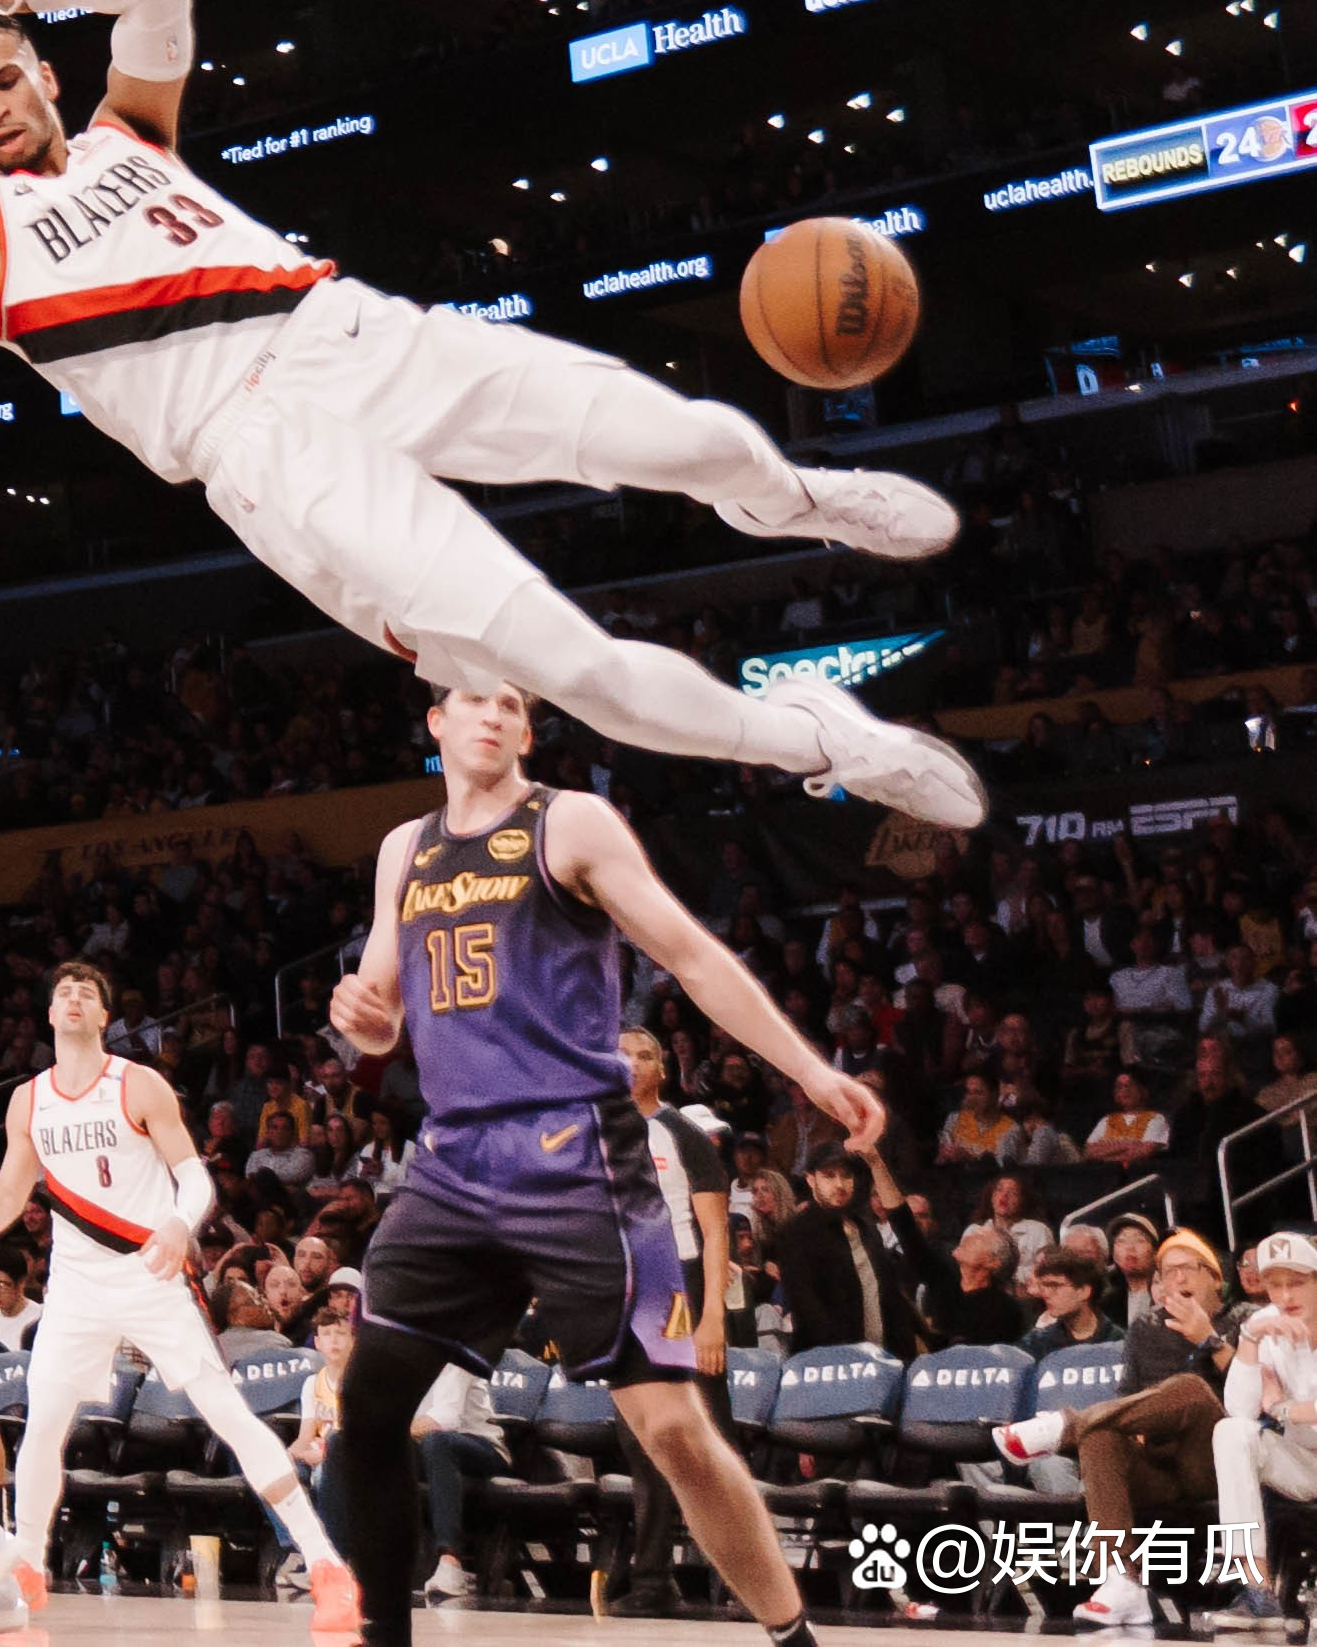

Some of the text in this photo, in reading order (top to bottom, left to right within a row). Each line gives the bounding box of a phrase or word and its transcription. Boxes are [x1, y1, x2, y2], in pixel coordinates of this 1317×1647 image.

[580, 8, 745, 70] UCLA Health
[265, 136, 288, 155] for
[289, 128, 309, 148] #1
[312, 115, 373, 142] ranking
[1101, 143, 1204, 186] REBOUNDS
[1214, 127, 1262, 166] 24
[22, 154, 172, 264] BLAZERS
[145, 193, 225, 248] 33
[582, 255, 711, 300] uclahealth.org
[1016, 812, 1086, 847] 710
[1129, 794, 1239, 837] ESPN
[426, 922, 498, 1013] 15
[38, 1118, 118, 1156] BLAZERS
[95, 1154, 113, 1189] 8
[246, 1357, 313, 1381] DELTA
[803, 1362, 878, 1383] DELTA
[936, 1367, 1011, 1387] DELTA
